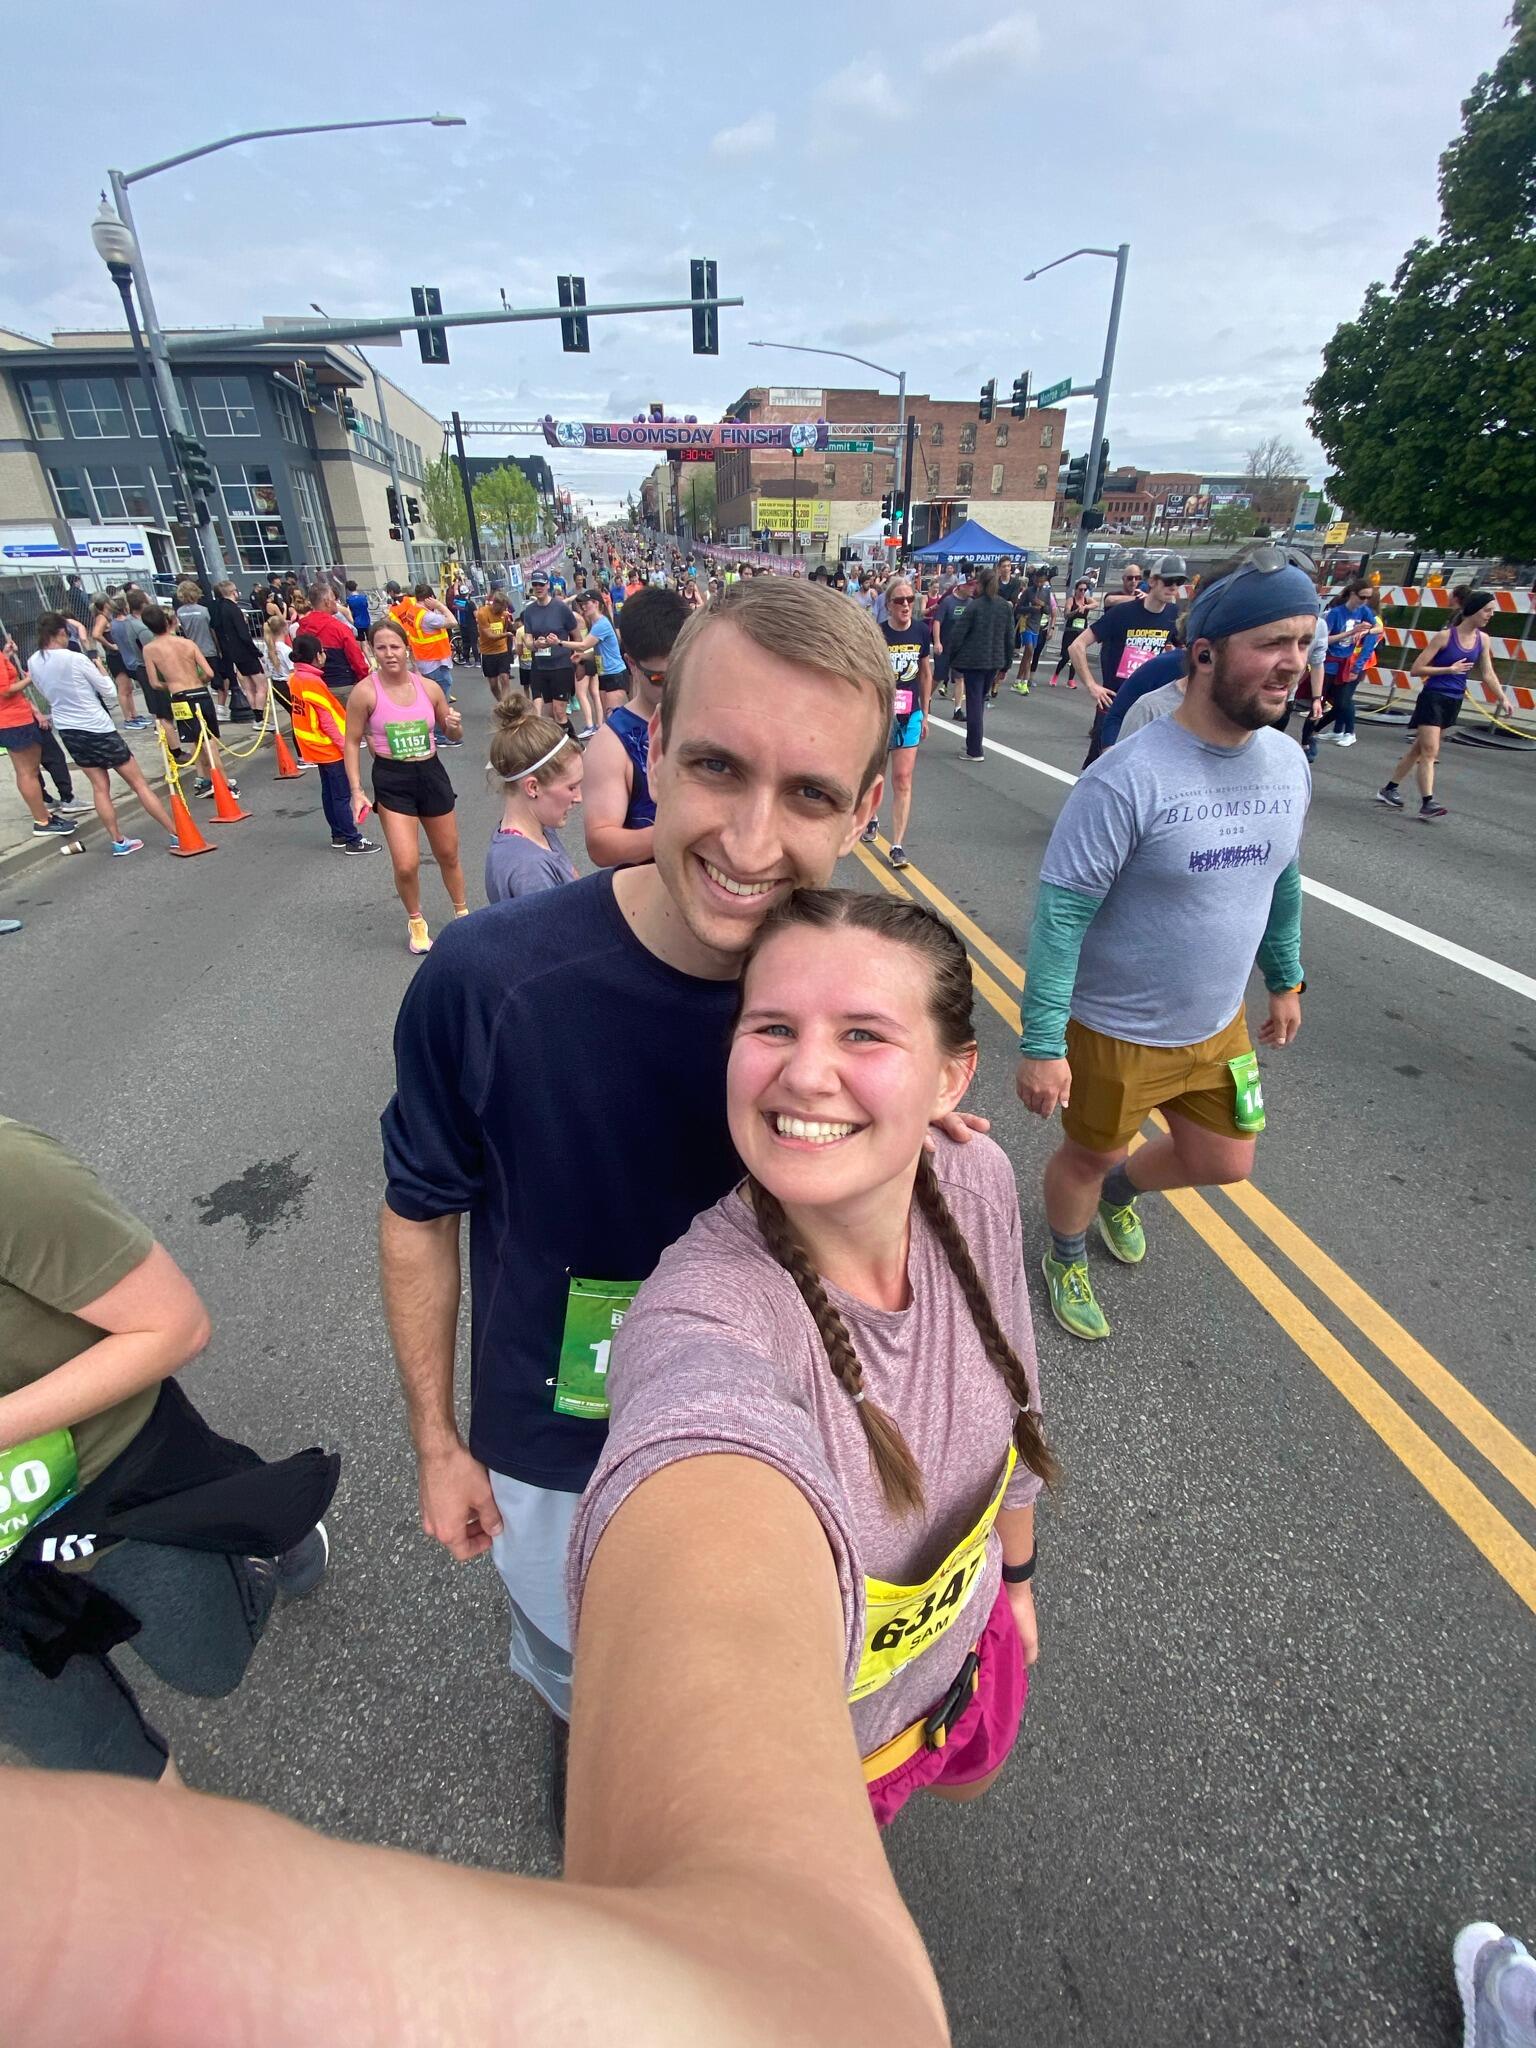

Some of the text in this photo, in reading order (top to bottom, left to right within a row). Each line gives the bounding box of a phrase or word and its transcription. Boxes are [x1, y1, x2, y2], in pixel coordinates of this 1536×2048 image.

[592, 427, 783, 445] BLOOMSDAY FINISH
[758, 518, 777, 528] FAMILY
[779, 519, 789, 528] TAX
[1126, 629, 1170, 637] BLOOMSDAY
[1126, 637, 1167, 646] CORPORATE
[393, 735, 426, 748] 11157
[1164, 799, 1292, 825] BLOOMSDAY
[1219, 826, 1245, 836] 2023
[909, 1615, 950, 1650] SAM
